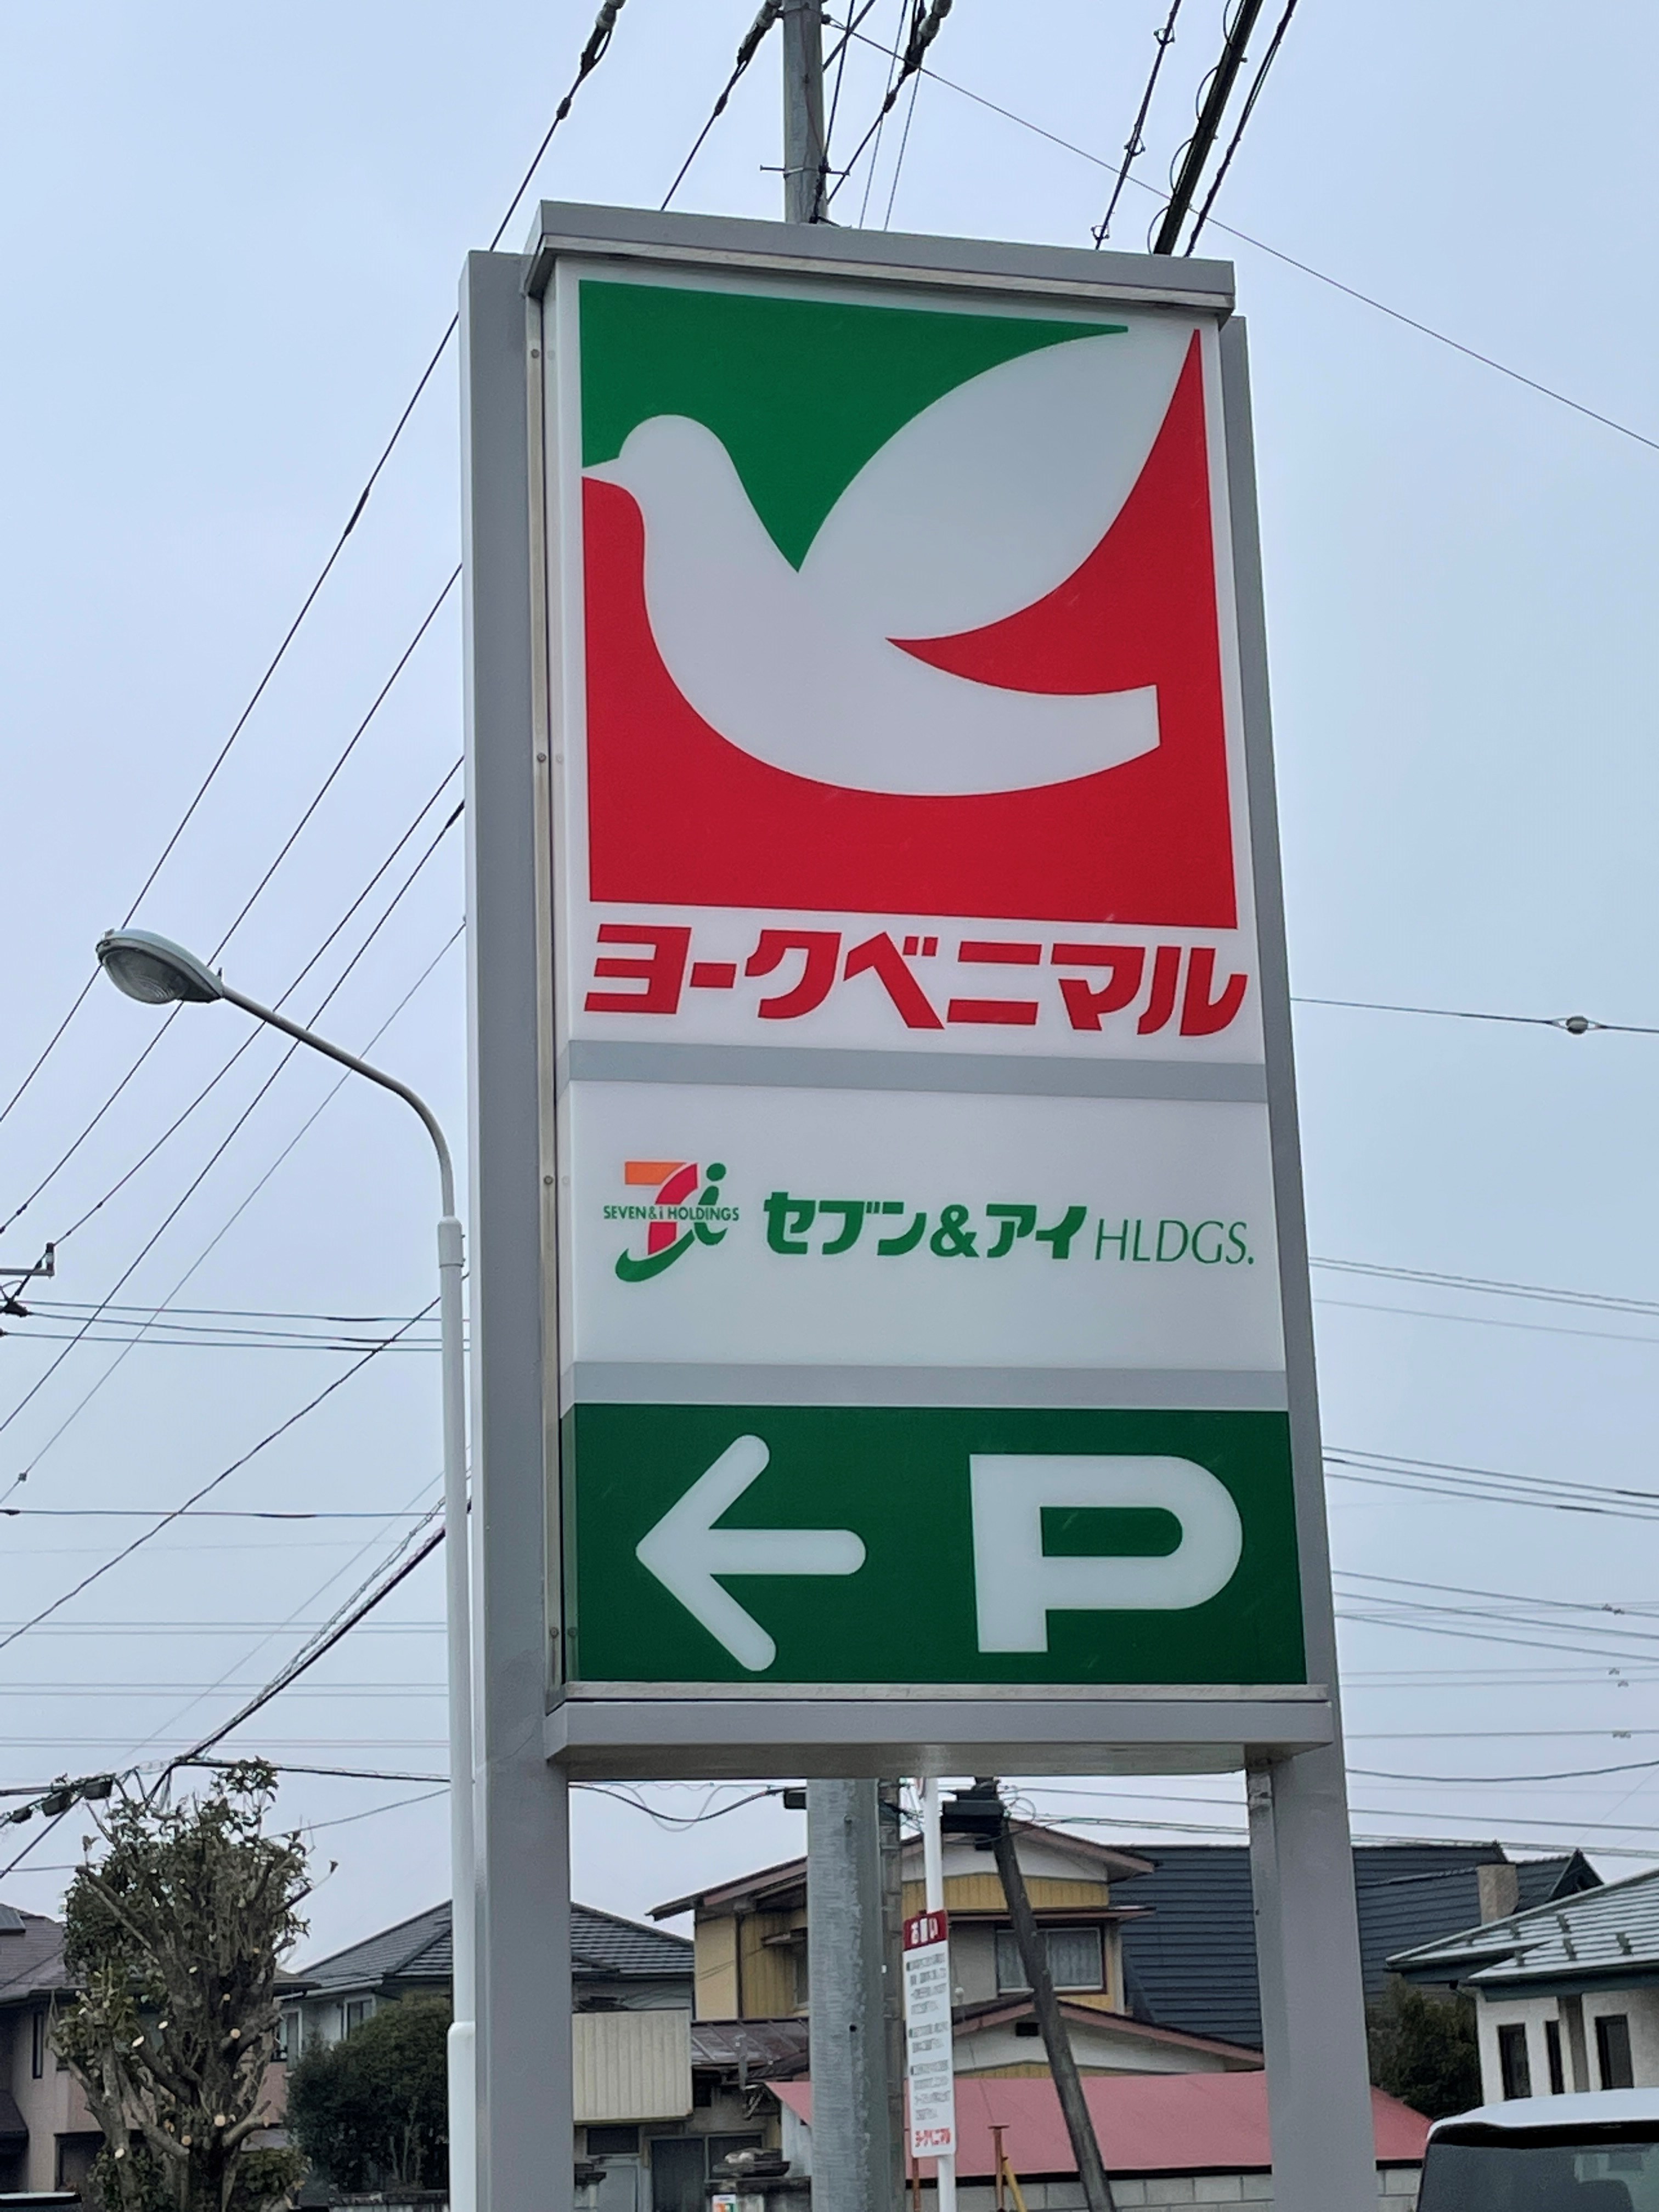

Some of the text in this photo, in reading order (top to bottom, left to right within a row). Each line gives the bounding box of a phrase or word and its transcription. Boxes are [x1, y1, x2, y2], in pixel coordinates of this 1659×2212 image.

[585, 923, 1248, 1036] ヨークベニマル
[668, 1207, 740, 1221] HOLDINGS
[969, 1454, 1243, 1653] P
